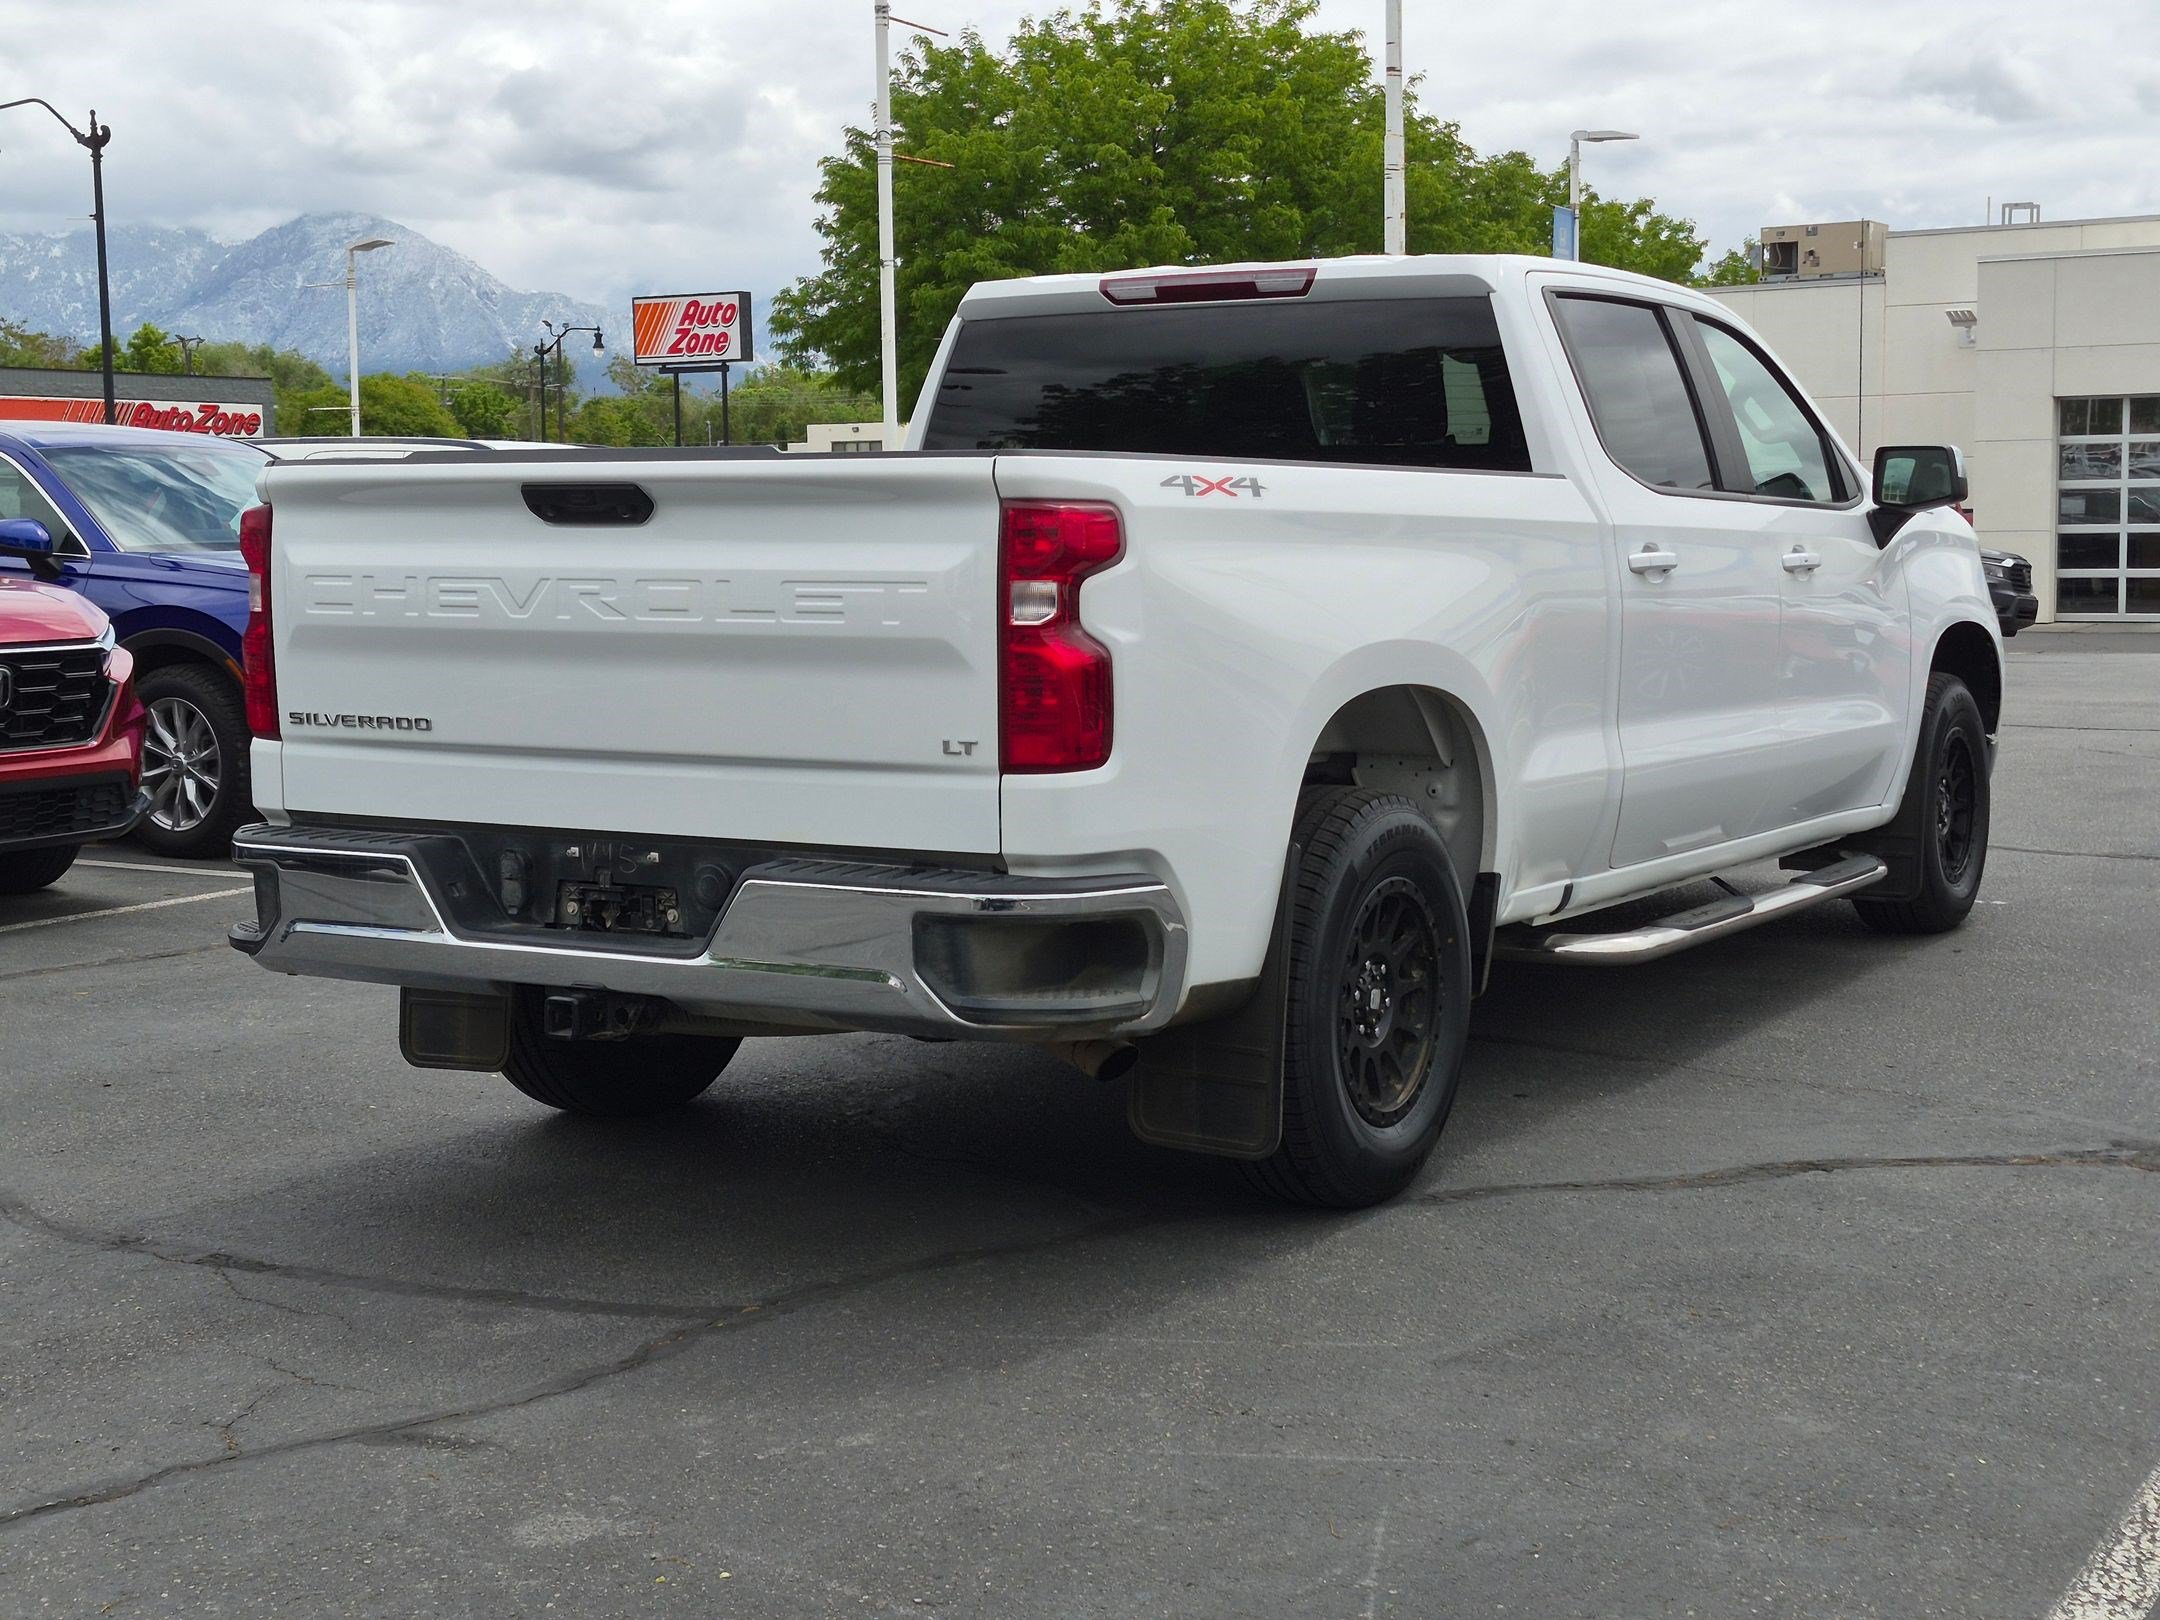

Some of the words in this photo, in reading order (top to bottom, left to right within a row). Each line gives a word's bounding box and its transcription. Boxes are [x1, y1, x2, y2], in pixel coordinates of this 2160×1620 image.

[678, 300, 737, 327] Auto
[666, 328, 730, 356] Zone
[129, 402, 262, 435] AutoZone
[304, 574, 927, 625] CHEVROLET
[289, 712, 432, 731] SILVERADO
[942, 739, 979, 756] LT
